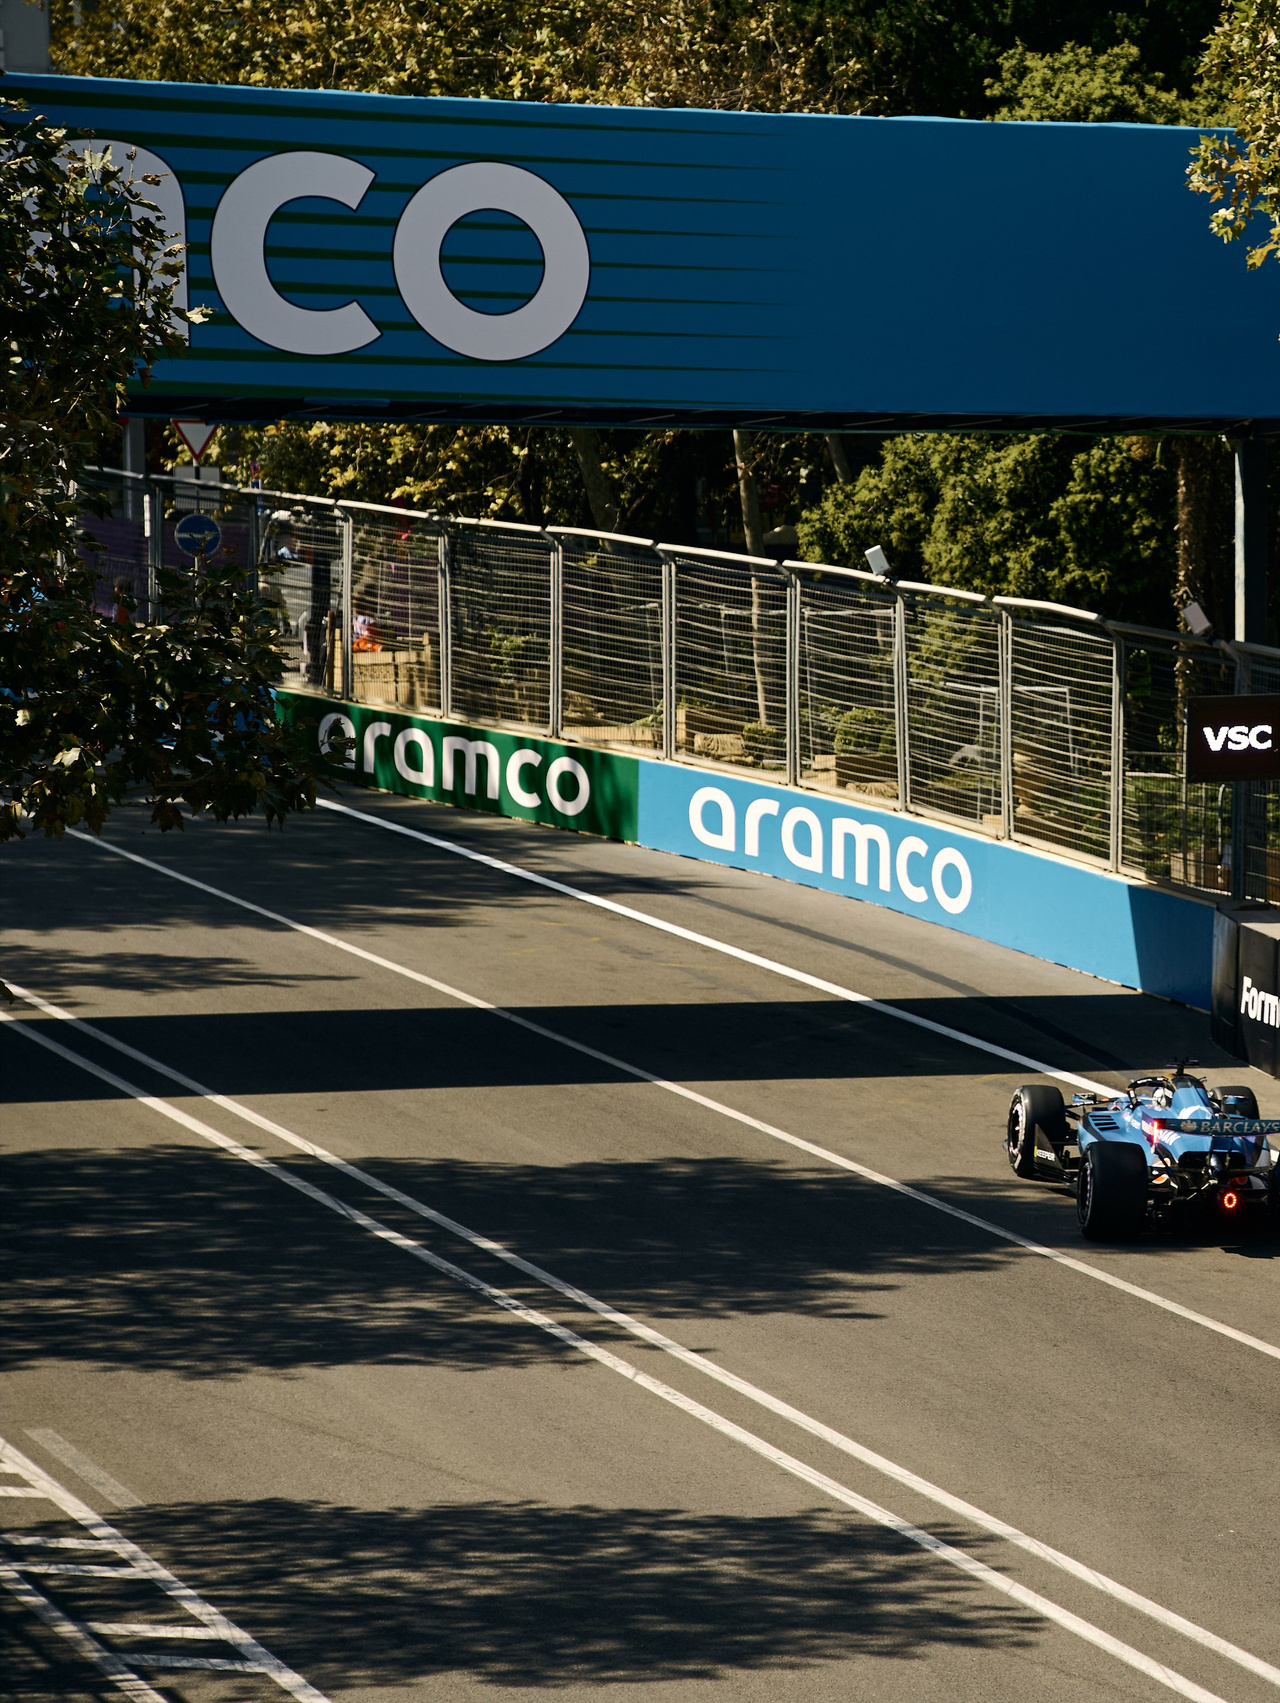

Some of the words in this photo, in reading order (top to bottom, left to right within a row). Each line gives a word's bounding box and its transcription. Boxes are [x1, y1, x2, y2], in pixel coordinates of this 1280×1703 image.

[317, 712, 591, 817] aramco
[1202, 724, 1273, 752] VSC
[688, 786, 973, 915] aramco
